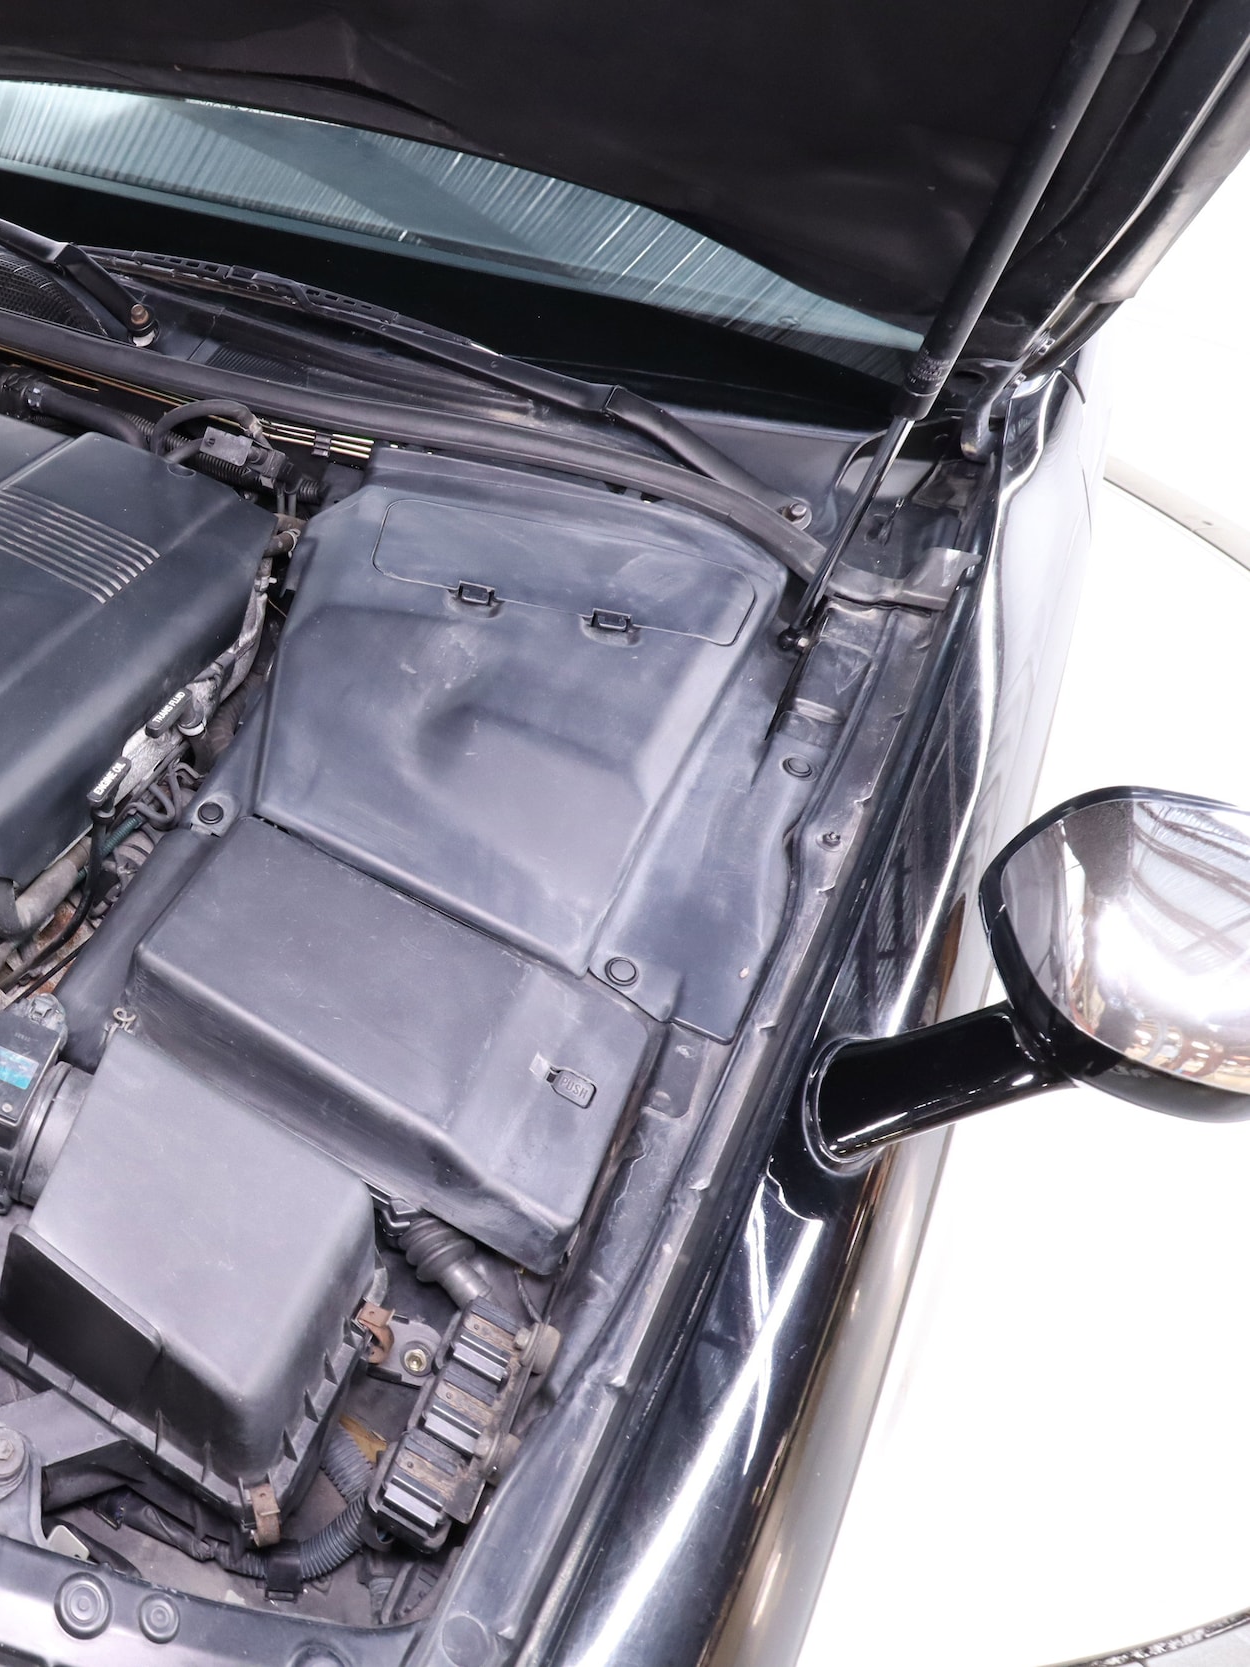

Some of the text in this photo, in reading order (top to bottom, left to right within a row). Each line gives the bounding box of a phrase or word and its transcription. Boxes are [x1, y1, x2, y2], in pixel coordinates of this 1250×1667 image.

[152, 691, 186, 723] TRANS FLUID
[93, 762, 126, 795] ENGINE OIL
[561, 1076, 588, 1099] PUSH
